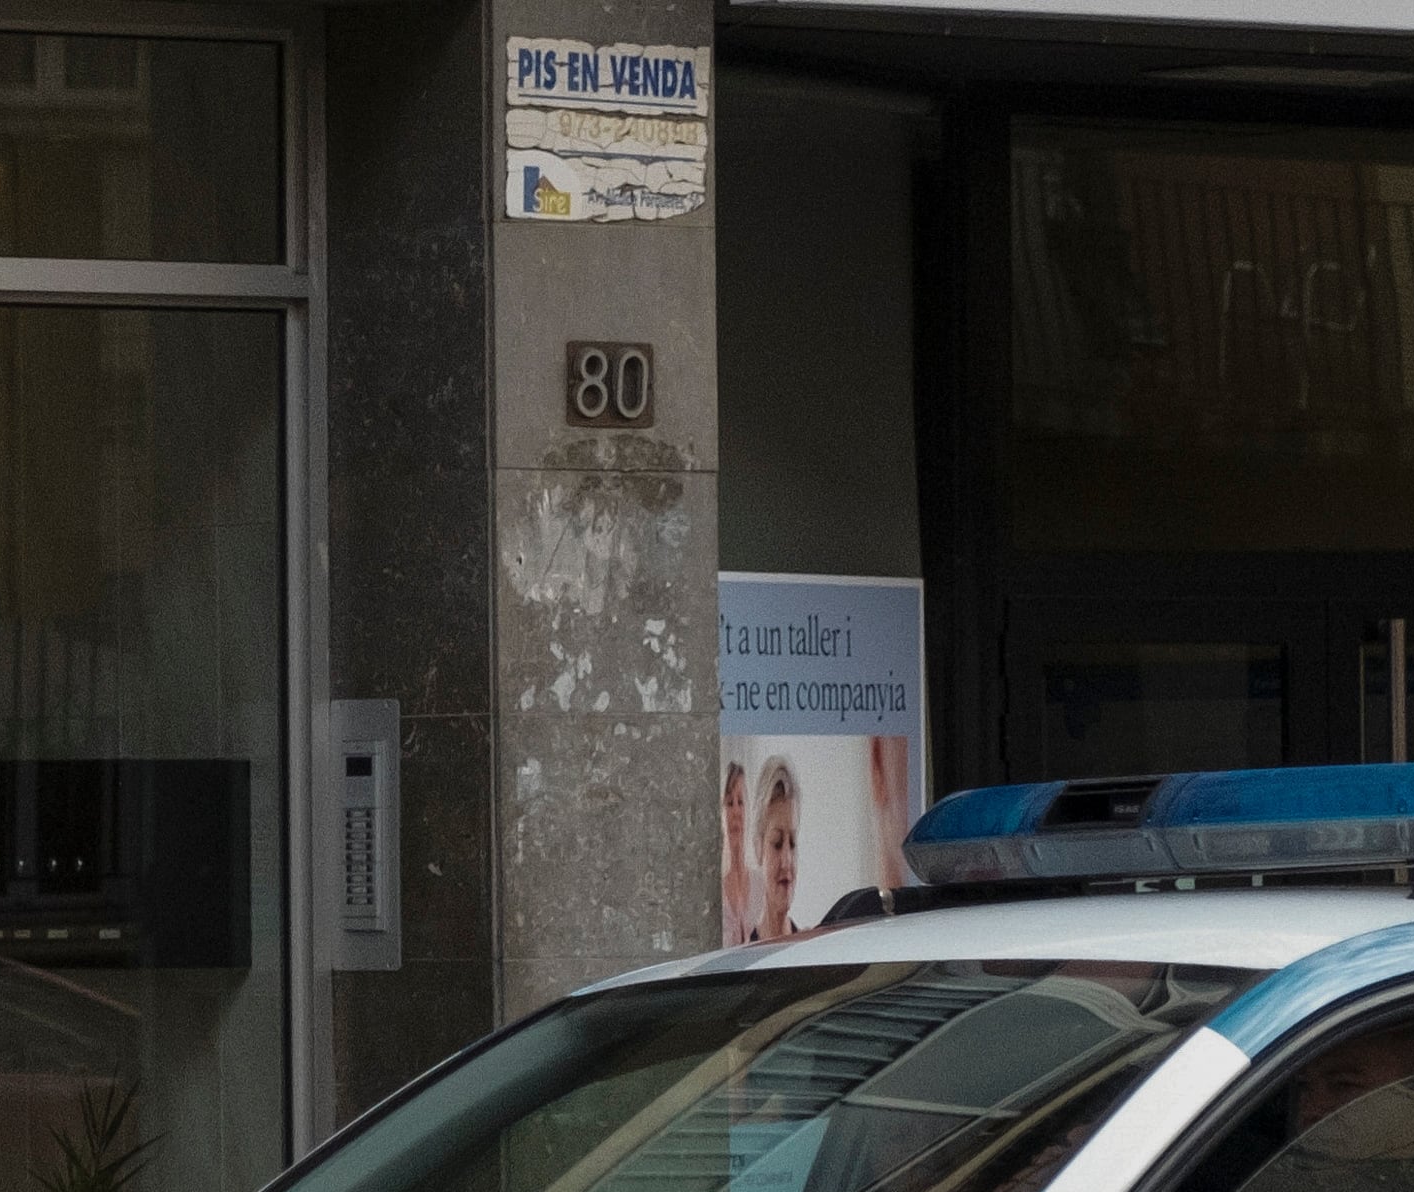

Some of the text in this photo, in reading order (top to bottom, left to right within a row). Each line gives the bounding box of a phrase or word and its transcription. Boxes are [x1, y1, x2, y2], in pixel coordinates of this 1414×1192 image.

[518, 48, 697, 100] PIS EN VENDA
[577, 348, 649, 418] 80
[739, 625, 751, 655] a
[756, 626, 782, 656] un
[789, 614, 841, 657] taller
[845, 615, 853, 657] i
[766, 681, 790, 711] en
[796, 670, 907, 722] companyia
